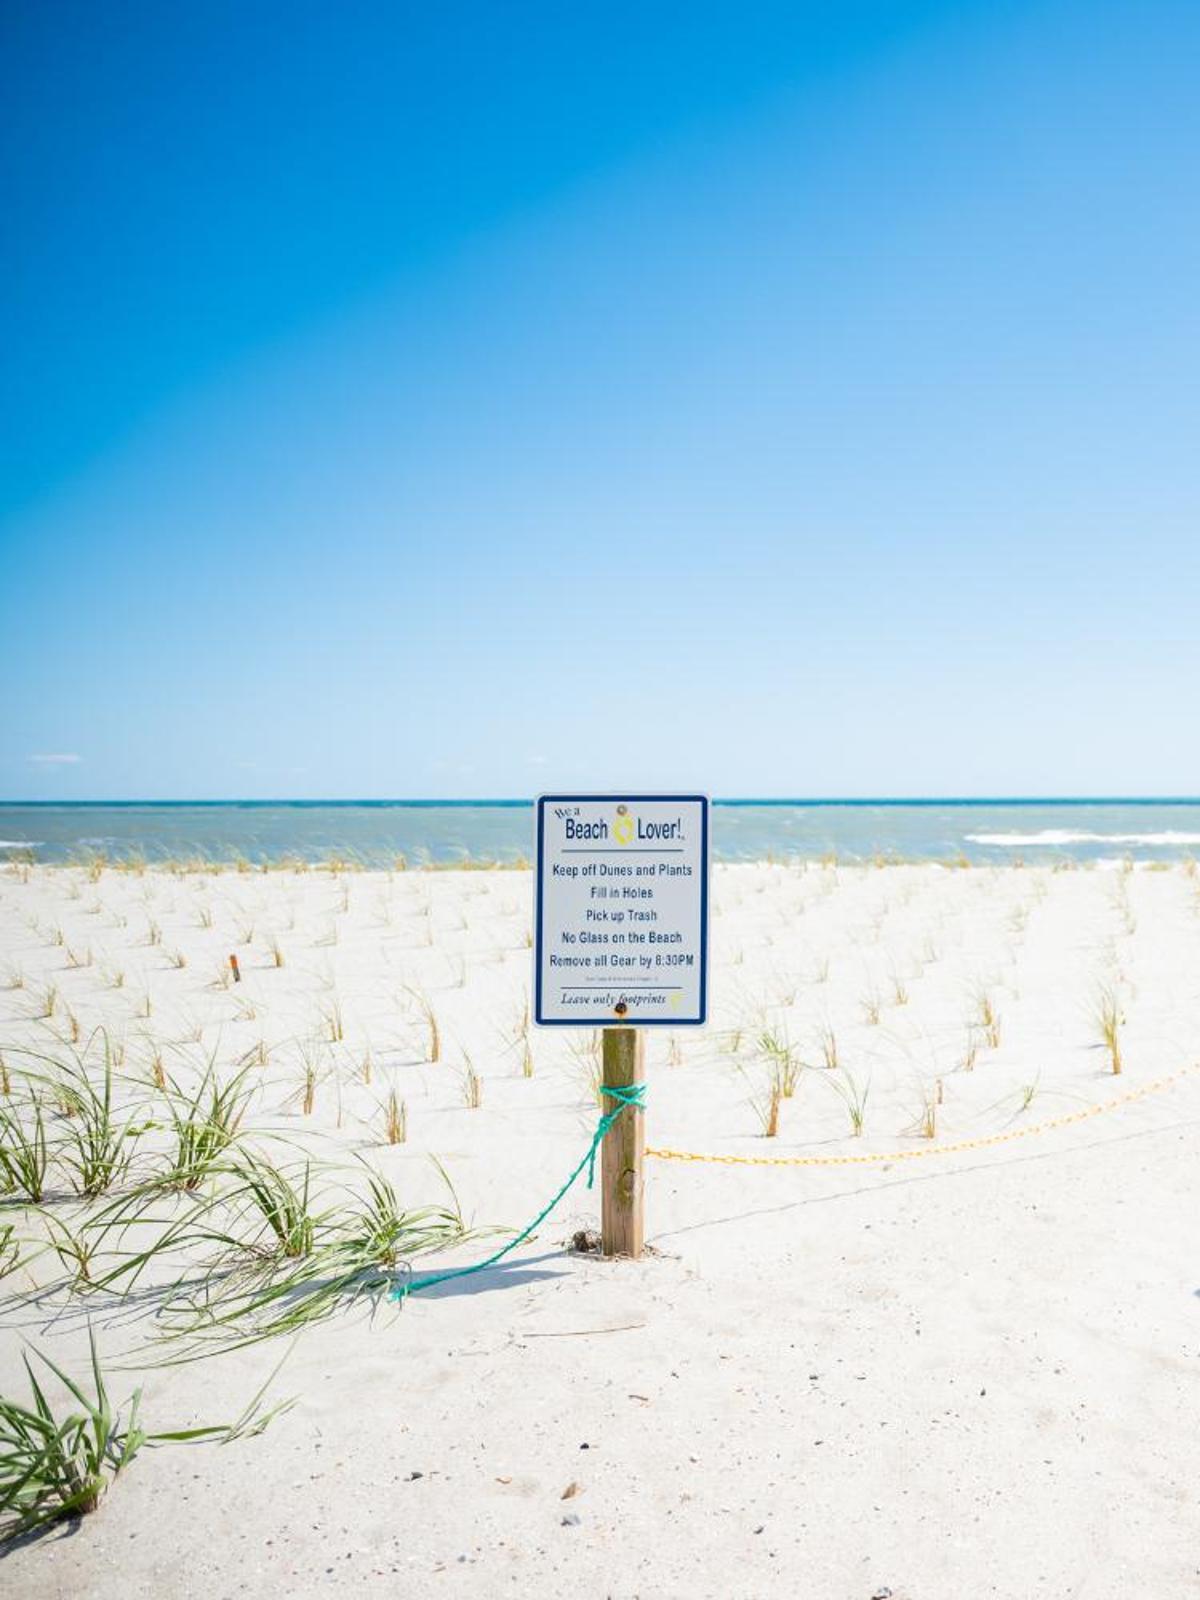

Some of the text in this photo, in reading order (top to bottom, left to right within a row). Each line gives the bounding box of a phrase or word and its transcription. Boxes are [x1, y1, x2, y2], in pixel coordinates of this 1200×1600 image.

[565, 818, 681, 839] Beach Lover!
[553, 864, 692, 878] Keep off Dunes and Plants
[591, 887, 653, 898] Fill in Holes
[586, 910, 657, 923] Pick up Trash
[562, 932, 682, 943] No Glass on the Beach
[550, 955, 591, 966] Remove
[594, 955, 607, 966] all
[610, 955, 635, 966] Gear
[639, 955, 652, 968] by
[561, 993, 666, 1007] Leave only footprints
